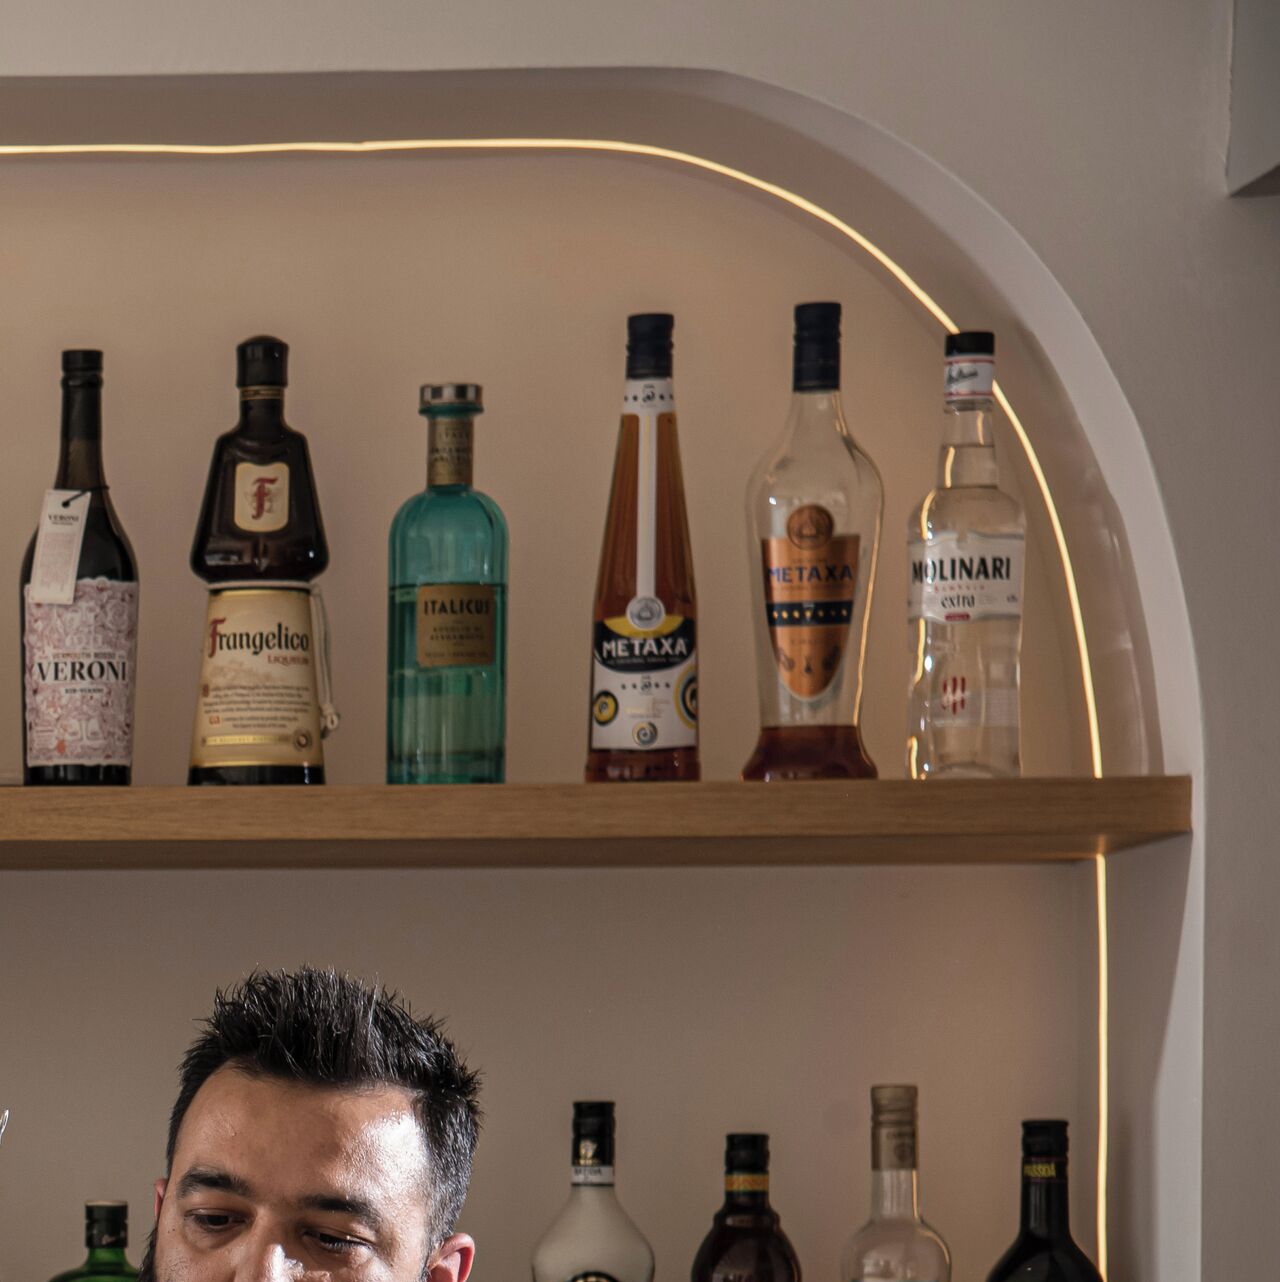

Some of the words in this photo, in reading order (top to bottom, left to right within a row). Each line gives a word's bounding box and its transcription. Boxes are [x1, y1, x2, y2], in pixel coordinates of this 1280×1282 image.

[767, 565, 853, 583] METAXA
[912, 557, 1011, 584] MOLINARI
[941, 594, 975, 609] extra
[208, 617, 310, 658] Frangelico
[602, 638, 688, 658] METAXA
[36, 661, 126, 682] VERONI
